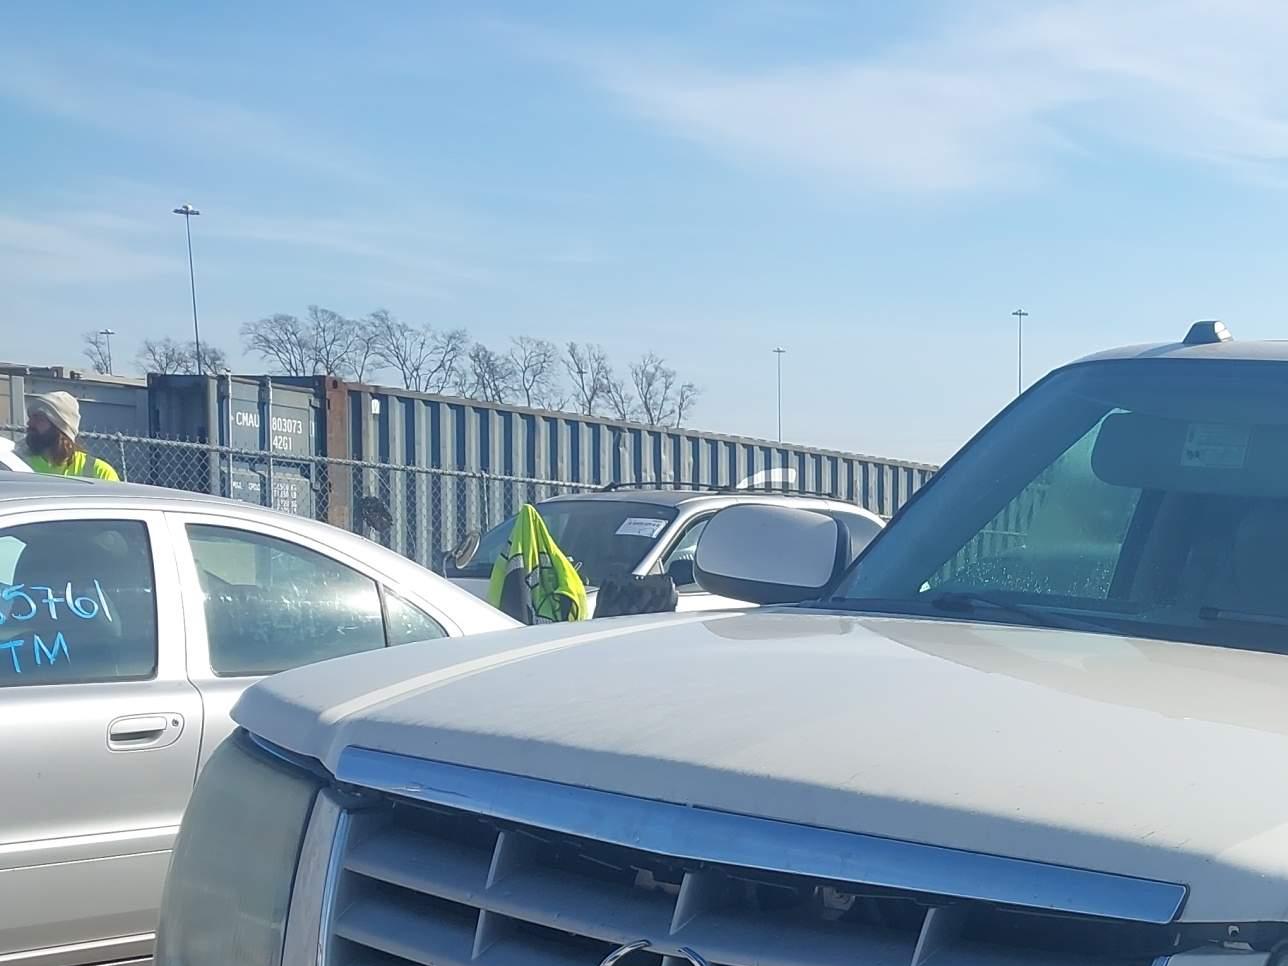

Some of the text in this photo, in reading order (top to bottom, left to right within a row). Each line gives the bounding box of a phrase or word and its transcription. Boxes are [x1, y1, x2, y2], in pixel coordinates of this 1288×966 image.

[236, 412, 303, 434] CMAU 803073
[273, 435, 292, 451] 42G1
[0, 578, 113, 624] 5761
